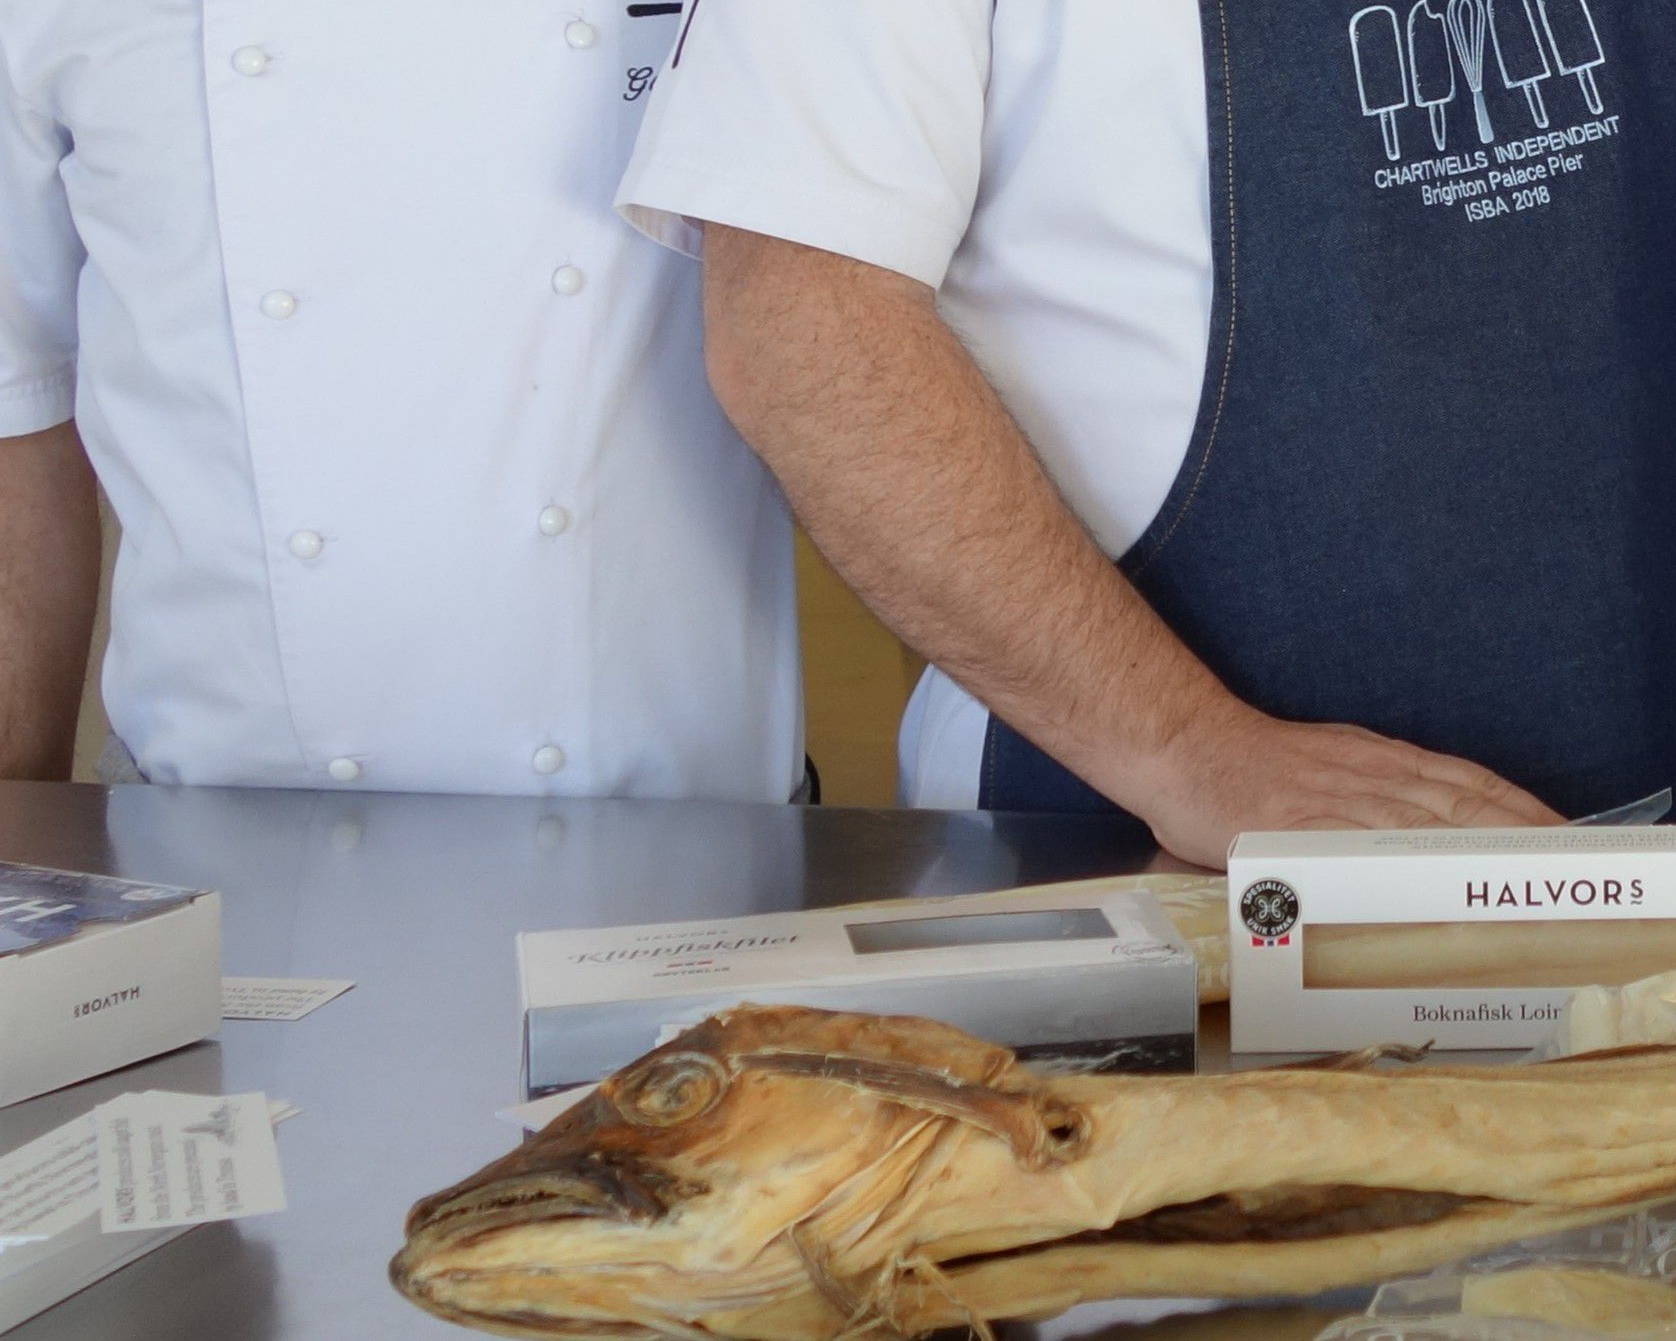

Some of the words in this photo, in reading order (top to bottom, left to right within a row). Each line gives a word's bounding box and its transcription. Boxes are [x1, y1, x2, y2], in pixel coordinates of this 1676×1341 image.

[1374, 151, 1488, 189] CHARTWELLS
[1495, 115, 1620, 163] INDEPENDENT
[1421, 179, 1488, 207] Brighton
[1488, 162, 1547, 192] Palace
[1549, 153, 1584, 177] Pier
[1464, 198, 1510, 223] ISBA
[1511, 186, 1551, 211] 2018
[1466, 879, 1644, 908] HALVORS
[74, 985, 141, 1019] HALVORS
[1413, 1003, 1513, 1022] Boknafisk
